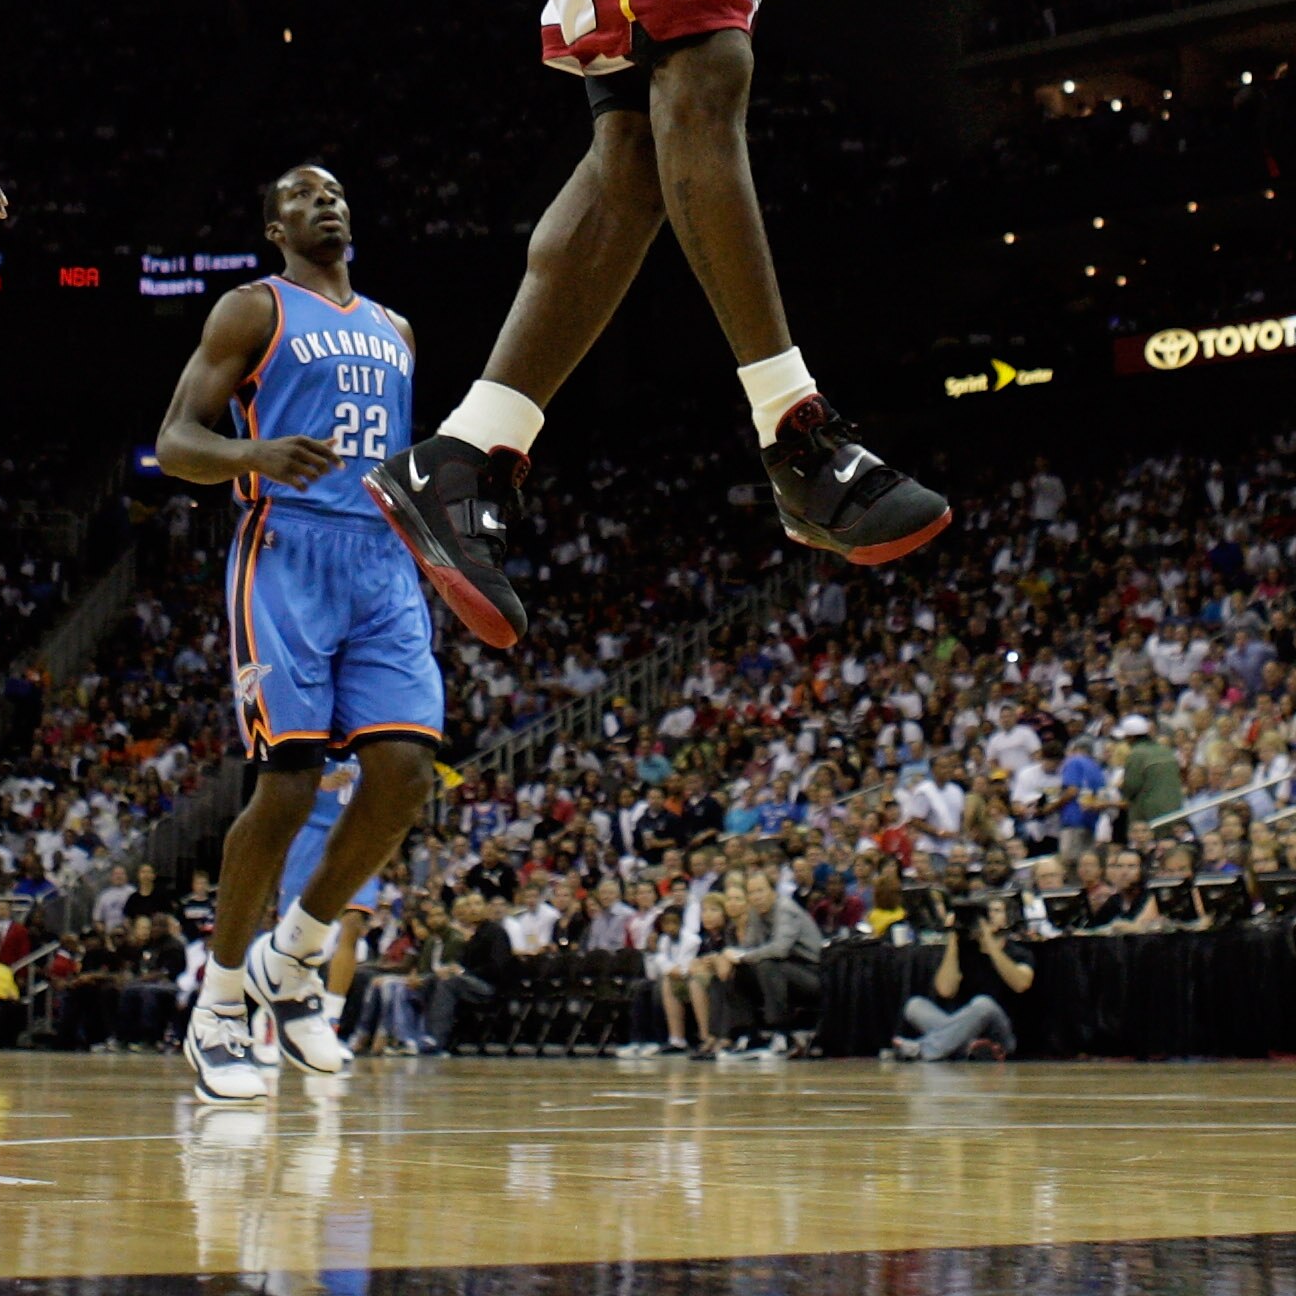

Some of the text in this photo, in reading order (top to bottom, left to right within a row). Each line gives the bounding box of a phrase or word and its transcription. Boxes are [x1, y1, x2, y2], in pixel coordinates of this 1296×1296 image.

[59, 266, 101, 288] NBA
[140, 254, 186, 273] Trail
[290, 329, 409, 376] OKLAHOMA
[337, 363, 385, 397] CITY
[943, 372, 989, 399] Sprint
[332, 401, 388, 460] 22
